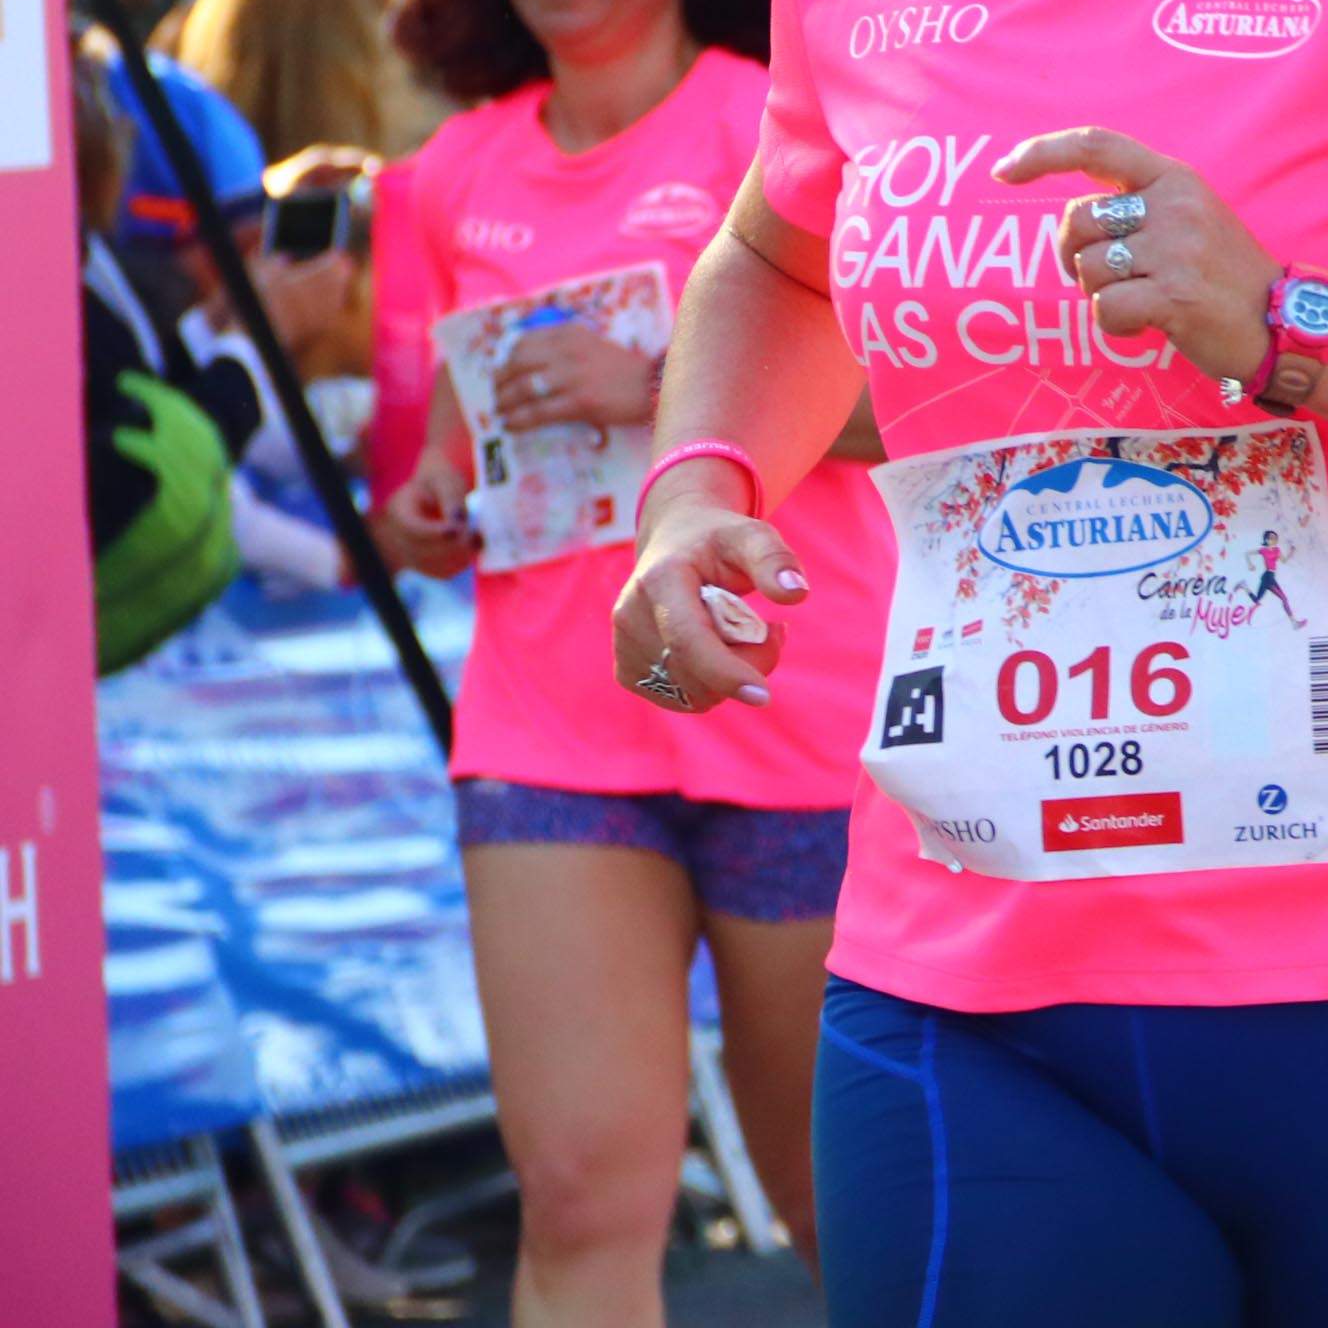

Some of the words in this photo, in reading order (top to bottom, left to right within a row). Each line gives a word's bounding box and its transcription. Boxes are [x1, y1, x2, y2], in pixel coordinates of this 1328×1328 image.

[849, 3, 989, 59] OYSHO
[1164, 2, 1311, 38] ASTURIANA
[846, 135, 992, 208] HOY
[1026, 497, 1099, 516] CENTRAL
[994, 509, 1196, 554] ASTURIANA
[1137, 571, 1230, 602] Carrera
[1159, 603, 1176, 621] de
[1179, 599, 1192, 619] la
[1190, 595, 1261, 640] Mujer
[996, 641, 1193, 727] 016
[1123, 724, 1138, 734] DE
[1045, 739, 1144, 781] 1028
[1080, 811, 1165, 832] Santander
[1234, 822, 1317, 843] ZURICH
